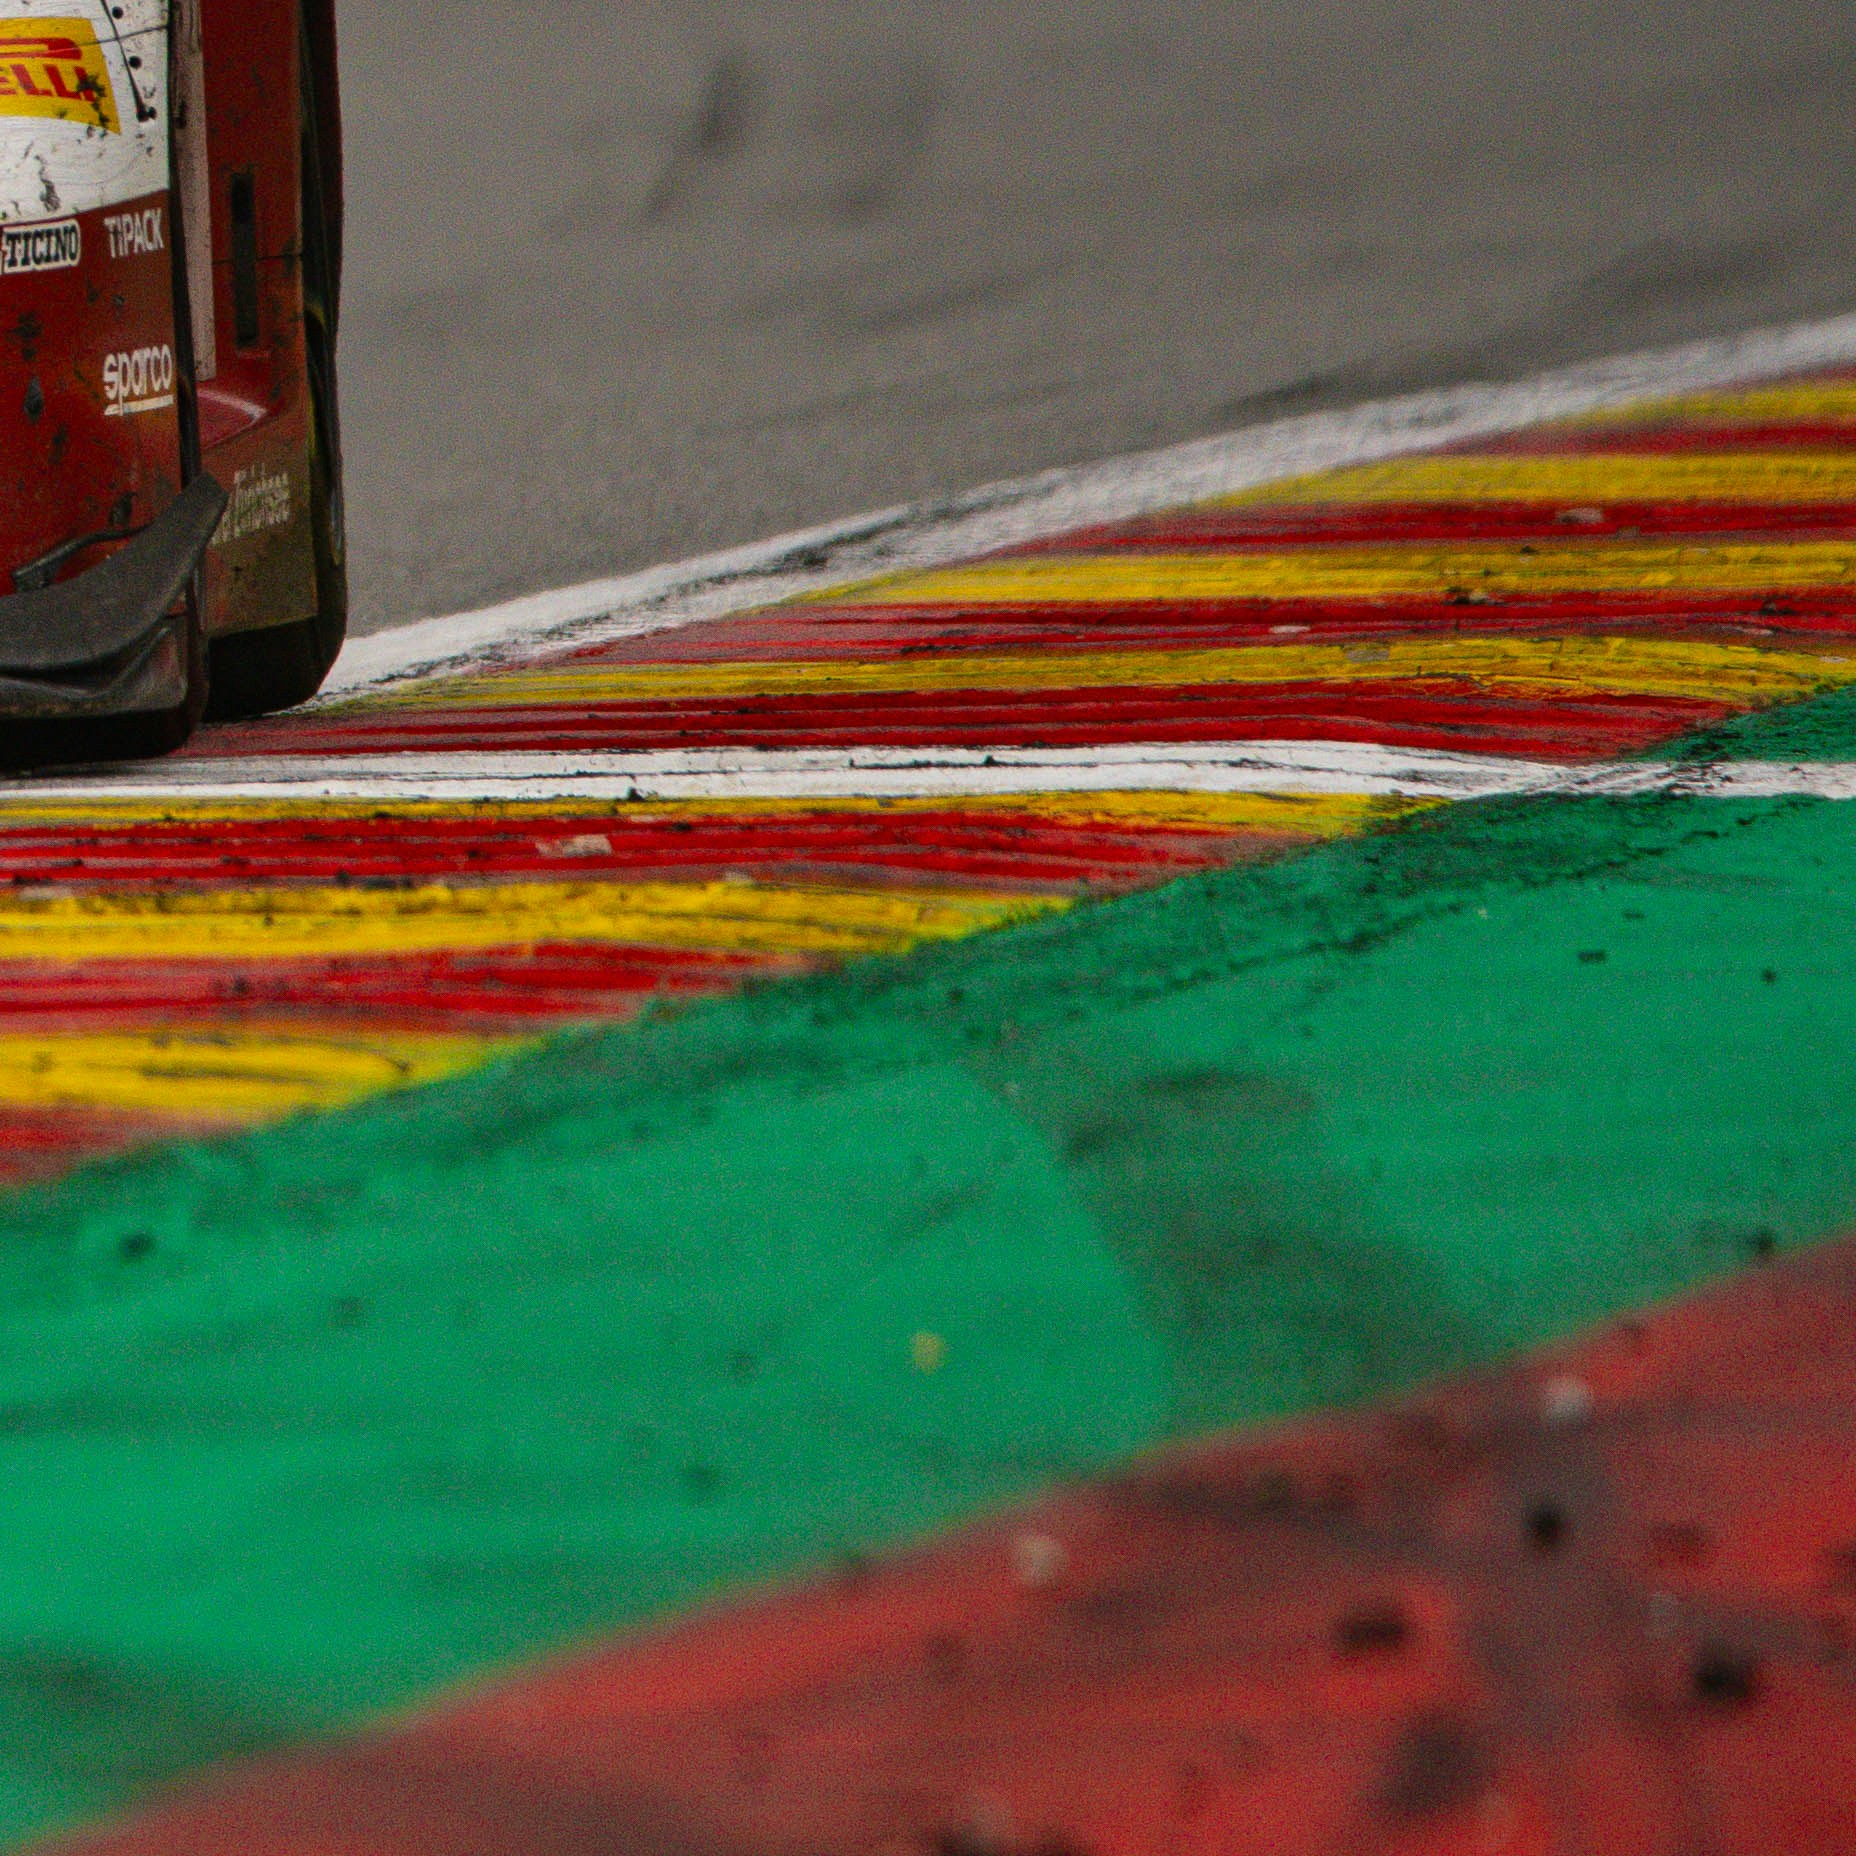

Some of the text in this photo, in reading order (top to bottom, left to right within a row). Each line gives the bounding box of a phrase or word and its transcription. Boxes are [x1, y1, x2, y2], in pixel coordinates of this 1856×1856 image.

[3, 224, 79, 268] TICINO
[104, 207, 164, 258] TIPACK
[104, 344, 172, 416] sparco
